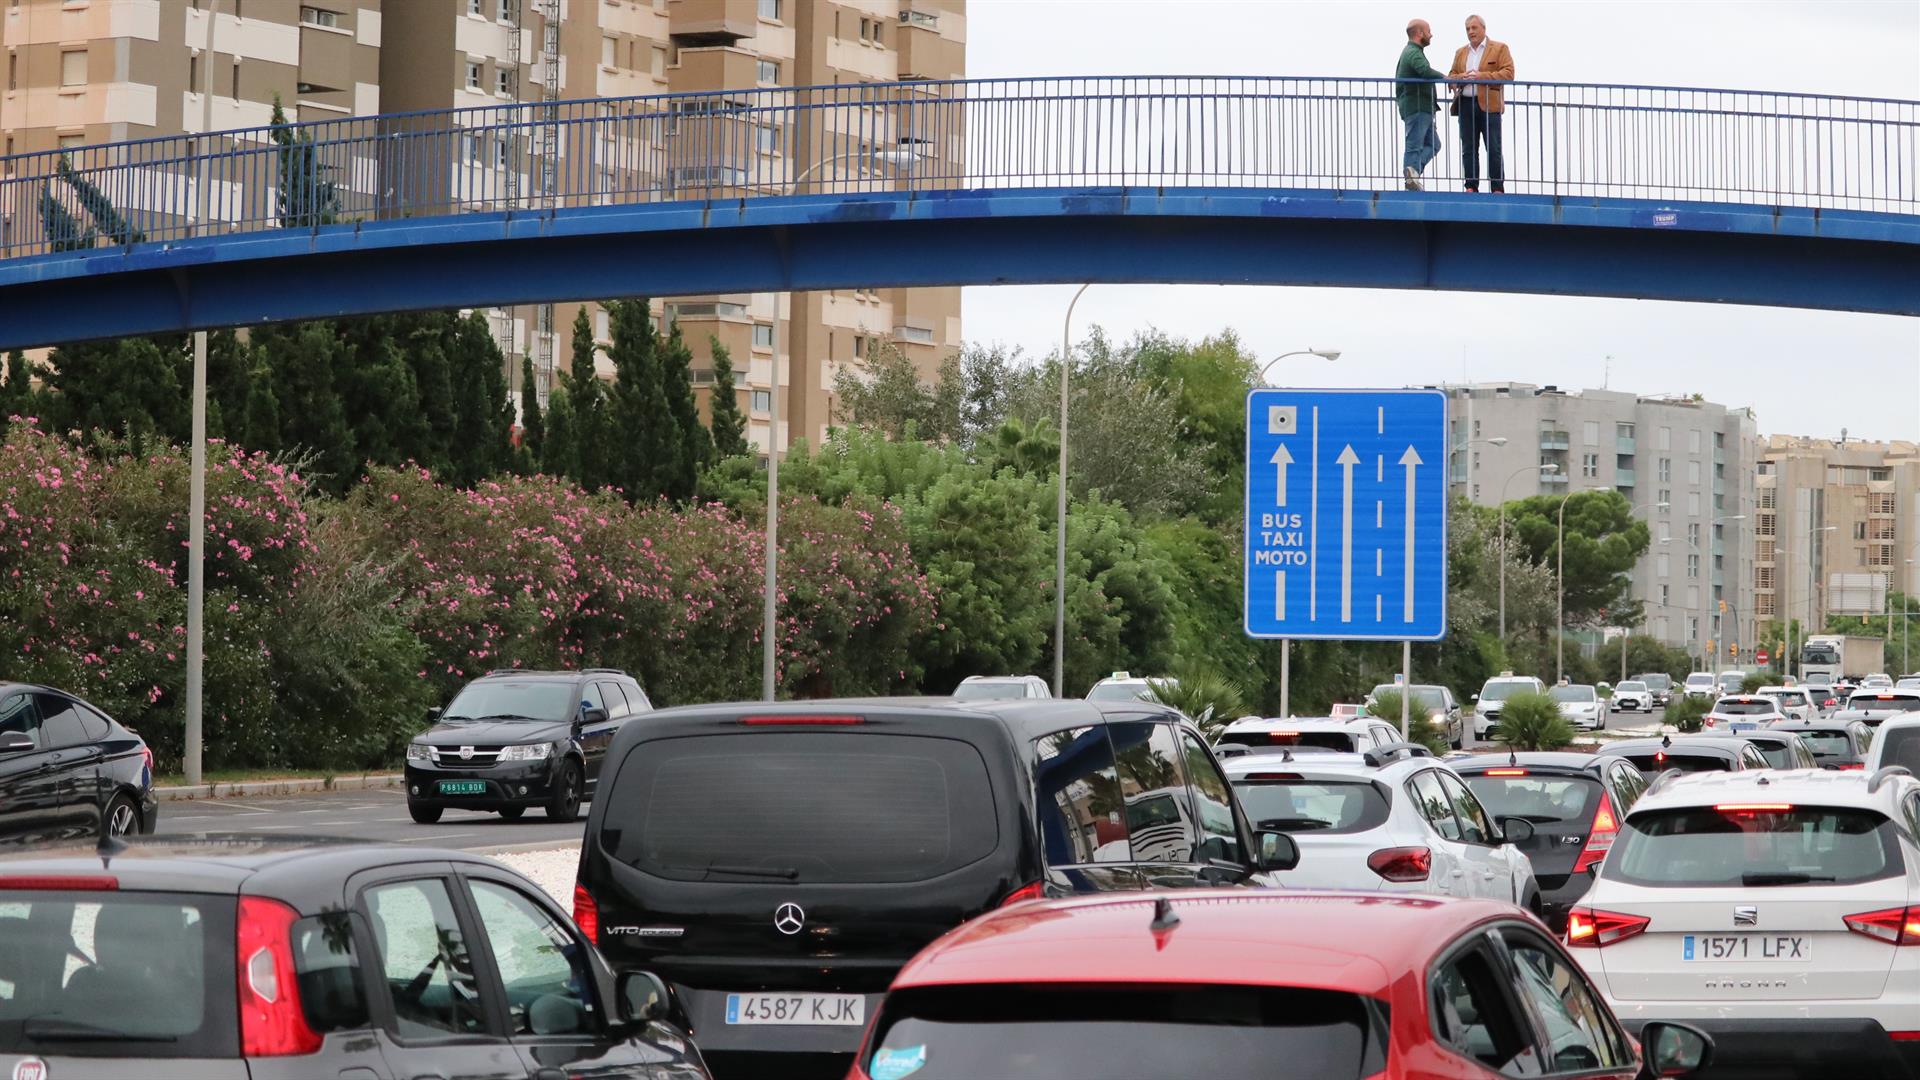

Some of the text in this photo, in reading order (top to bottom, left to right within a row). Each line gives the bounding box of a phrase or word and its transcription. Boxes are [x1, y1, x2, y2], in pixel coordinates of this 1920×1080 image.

[1262, 513, 1302, 529] BUS
[1261, 531, 1303, 547] TAXI
[1255, 550, 1307, 566] MOTO
[606, 926, 639, 935] VITO
[1701, 937, 1749, 959] 1571
[1762, 937, 1803, 959] LFX
[1705, 979, 1787, 989] ARONA
[744, 998, 857, 1021] 4587 KJK
